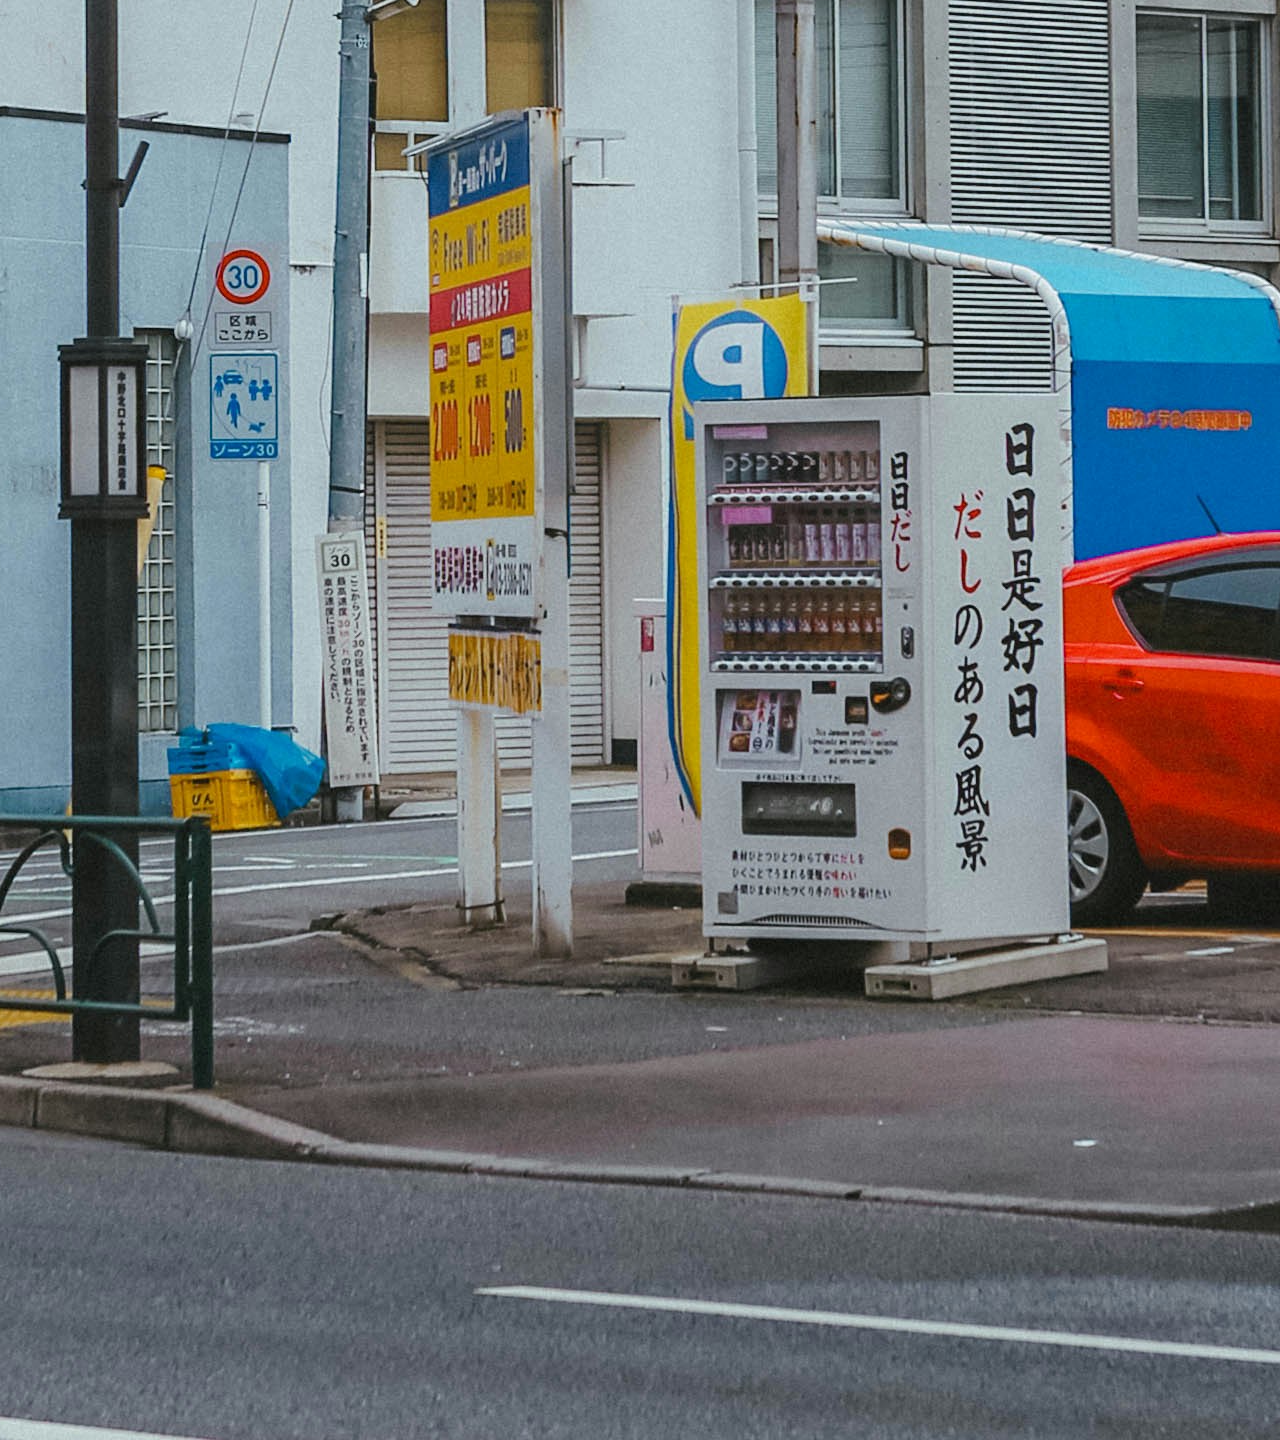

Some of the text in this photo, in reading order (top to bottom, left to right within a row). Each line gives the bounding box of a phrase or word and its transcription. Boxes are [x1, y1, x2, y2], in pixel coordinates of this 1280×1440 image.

[443, 231, 463, 272] Free
[466, 217, 491, 266] Wi-Fi
[228, 265, 258, 289] 30
[219, 329, 268, 341] ここから
[213, 444, 275, 457] ゾーン30
[889, 451, 910, 572] 日日だし
[330, 554, 351, 567] 30
[1001, 422, 1044, 739] 日日是好日
[953, 489, 990, 873] だしのある風景
[192, 793, 213, 805] びん
